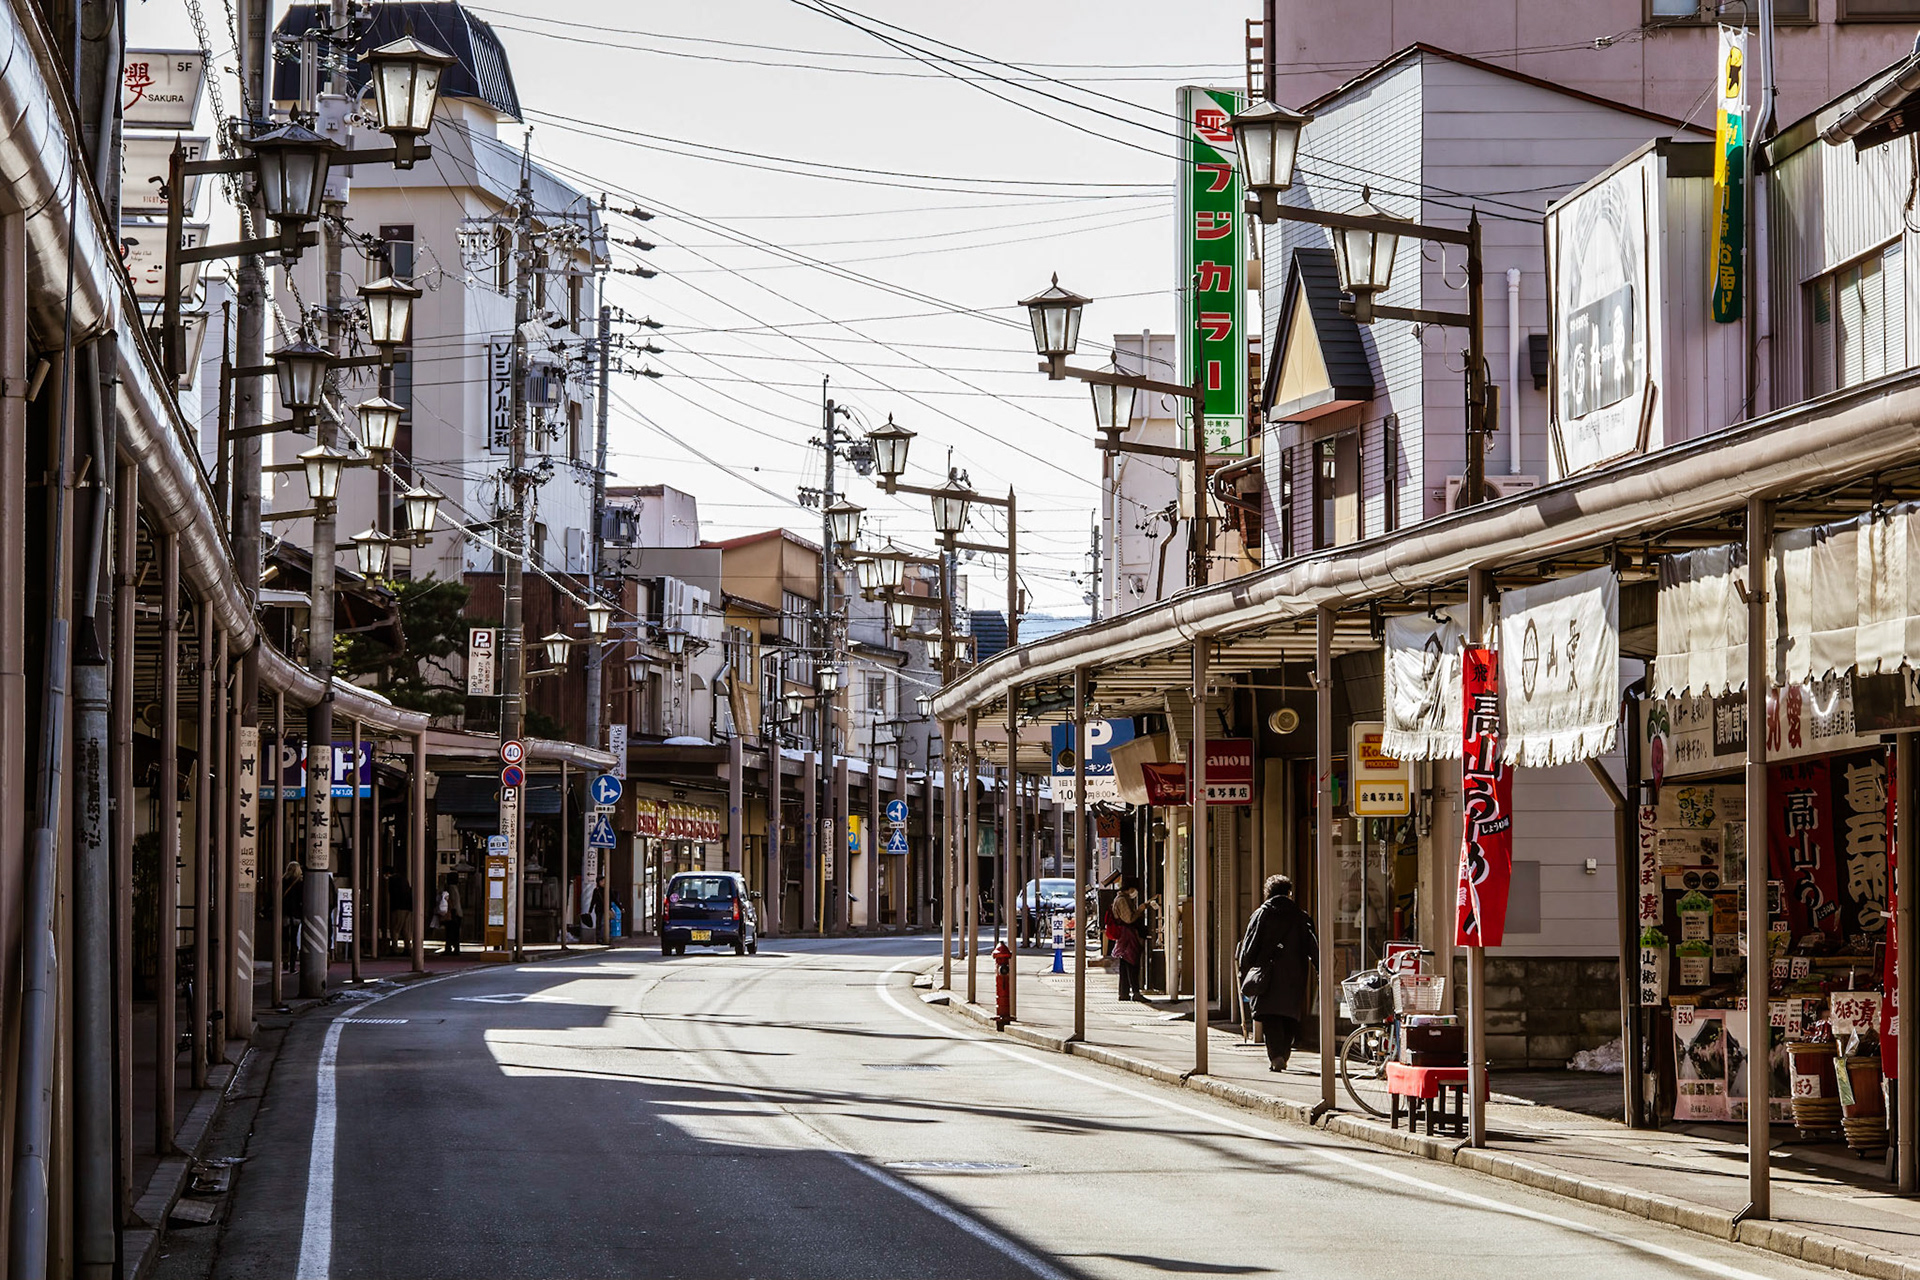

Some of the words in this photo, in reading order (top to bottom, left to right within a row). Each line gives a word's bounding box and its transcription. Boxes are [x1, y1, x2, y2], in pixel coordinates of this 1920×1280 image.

[177, 62, 193, 72] 5F
[148, 94, 184, 103] SAKURA
[1195, 162, 1234, 391] フジカラー
[474, 632, 489, 647] P
[1085, 720, 1113, 760] P
[506, 747, 520, 758] 40
[268, 744, 298, 781] P
[334, 747, 367, 781] P
[1205, 755, 1251, 767] anon
[503, 788, 515, 800] P
[1207, 787, 1248, 798] 亀写真店
[1053, 919, 1064, 945] 空車
[1792, 965, 1808, 978] 530
[1738, 999, 1748, 1011] 53
[1678, 1012, 1693, 1025] 530
